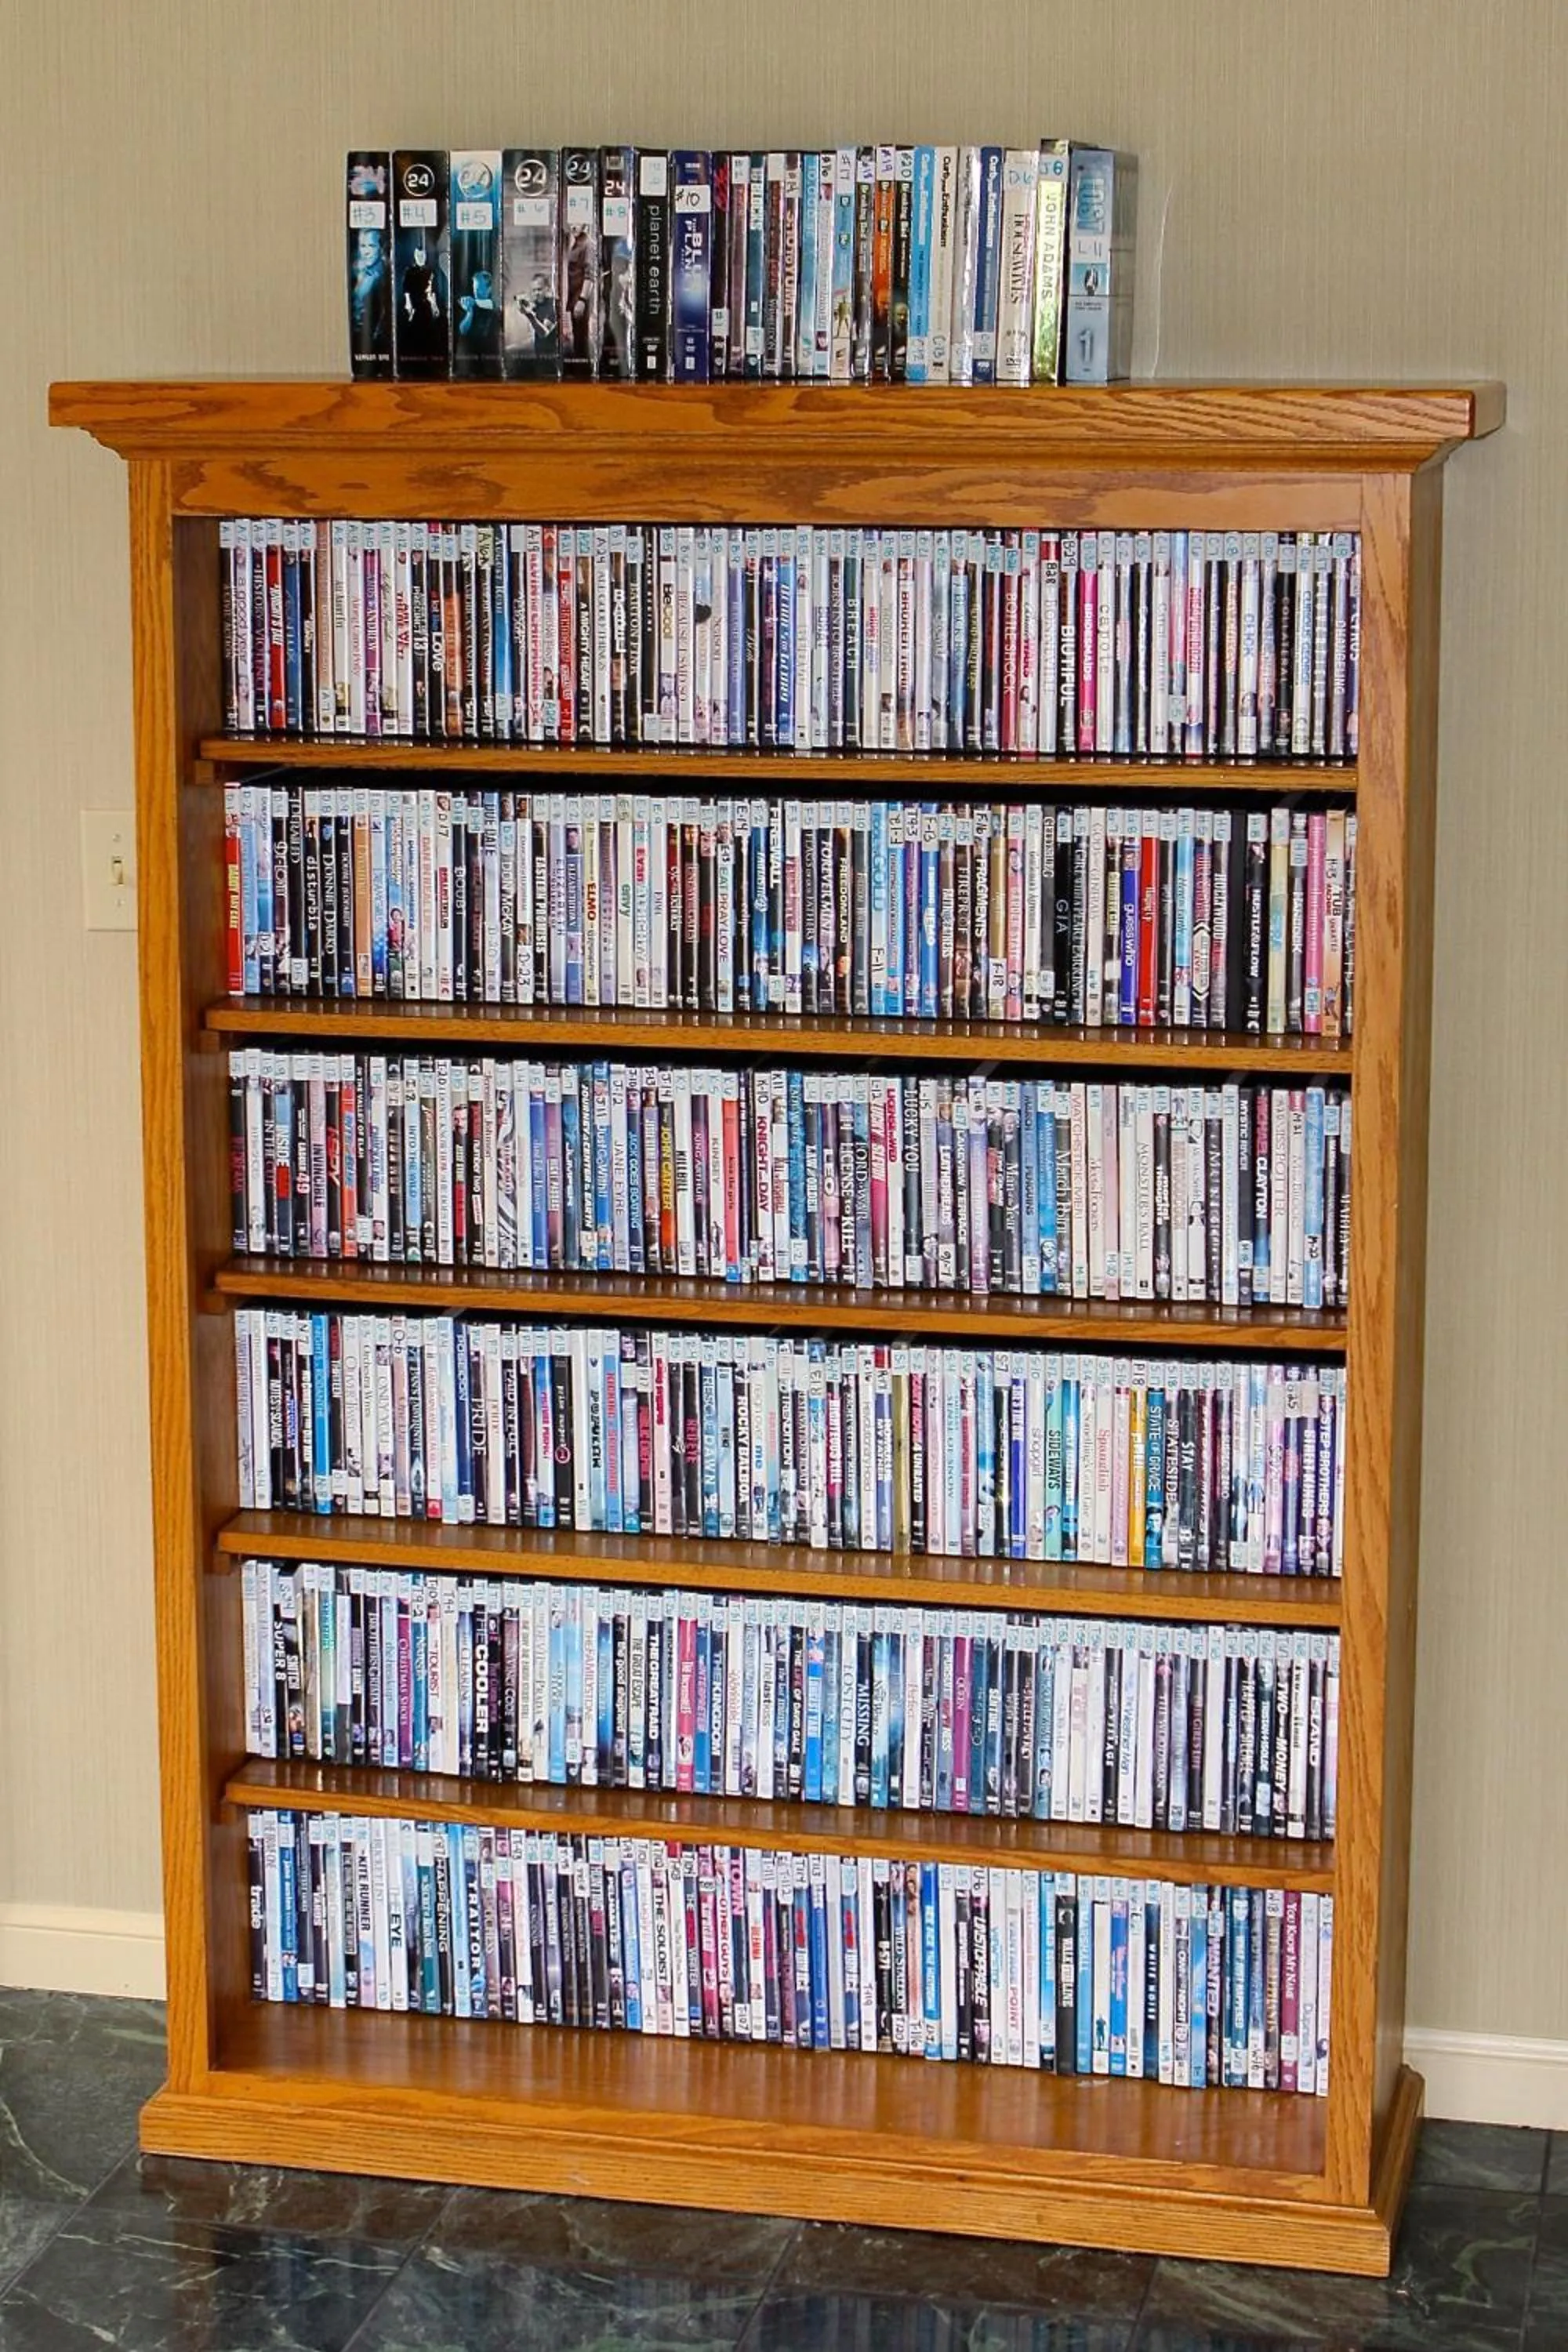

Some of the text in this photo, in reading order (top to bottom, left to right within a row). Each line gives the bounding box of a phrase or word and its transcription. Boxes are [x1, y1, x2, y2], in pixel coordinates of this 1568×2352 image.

[407, 173, 430, 188] 24
[648, 270, 660, 315] earth
[847, 598, 858, 670] BREACH
[1004, 644, 1016, 695] SHOCK
[1061, 625, 1075, 706] BIUTIFUL
[637, 848, 645, 882] Evan
[770, 807, 780, 888] FIREWALL
[307, 855, 318, 931] disturbia
[587, 882, 597, 921] ELMO
[720, 893, 728, 927] PRAY
[975, 858, 985, 938] FRAGMENTS
[1056, 899, 1066, 934] GIA
[324, 910, 336, 954] DARKO
[720, 929, 728, 963] LOVE
[887, 1088, 896, 1131] LICENSE
[906, 1089, 918, 1136] LUCKY
[297, 1173, 310, 1193] 49
[662, 1126, 673, 1211] JOHN CARTER
[759, 1182, 769, 1212] DAY
[823, 1149, 835, 1196] LEO
[1256, 1157, 1267, 1218] CLAYTON
[840, 1142, 853, 1253] LICENSE KILL
[471, 1398, 485, 1456] PRIDE
[738, 1396, 749, 1503] ROCKY BALBOA
[1149, 1406, 1160, 1439] STATE
[704, 1434, 715, 1486] DAWN
[1048, 1430, 1061, 1490] SIDEWAYS
[1166, 1419, 1178, 1501] STATESIDE
[1181, 1442, 1193, 1472] STAY
[1319, 1416, 1330, 1515] STEP BROTHERS
[429, 1650, 439, 1698] TOURIST
[475, 1644, 488, 1733] COOLER
[857, 1683, 869, 1746] MISSING
[1309, 1696, 1319, 1766] ISLAND
[1275, 1737, 1287, 1791] MONEY
[358, 1856, 370, 1931] KITE RUNNER
[437, 1860, 447, 1952] HAPPENING
[391, 1914, 401, 1947] EYE
[468, 1880, 480, 1969] TRAITOR
[657, 1924, 667, 1981] SOLOIST
[975, 1916, 987, 2007] UNSTOPPABLE
[1208, 1937, 1219, 2016] WANTED
